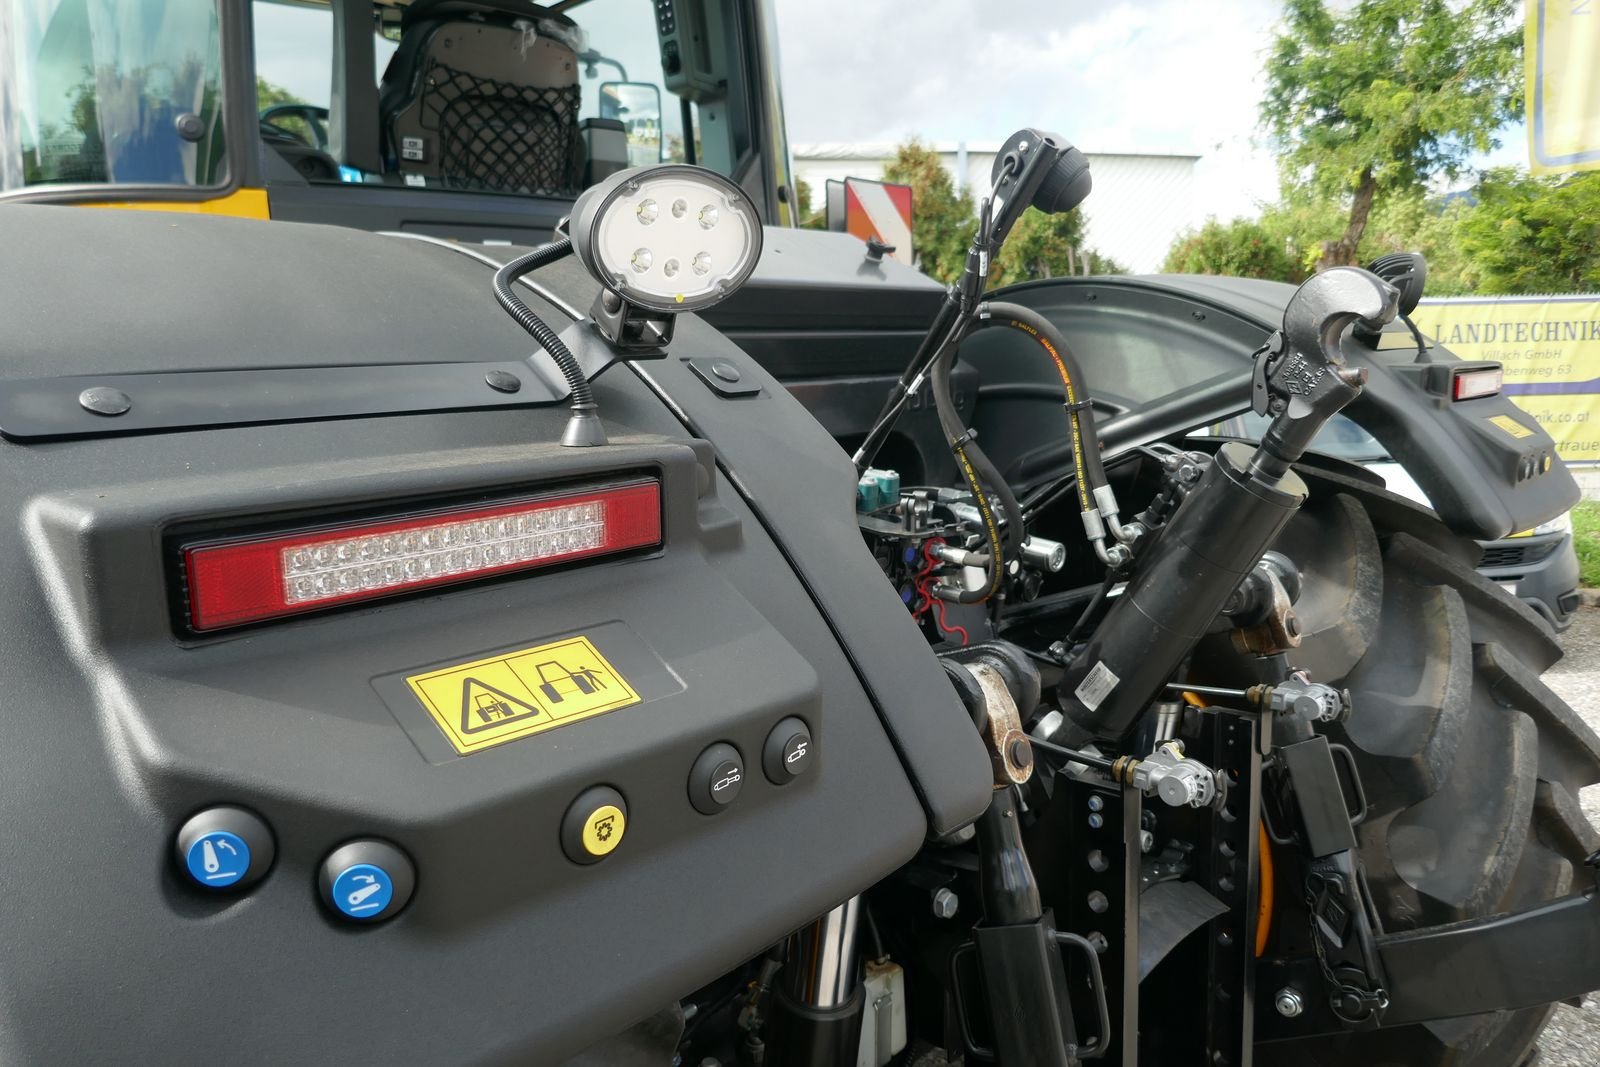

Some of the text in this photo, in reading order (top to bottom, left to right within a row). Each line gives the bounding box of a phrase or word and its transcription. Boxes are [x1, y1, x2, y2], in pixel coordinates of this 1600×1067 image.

[1434, 320, 1600, 345] LANDTECHNIK
[1481, 349, 1562, 361] Villach GmbH
[1503, 364, 1572, 378] benweg 63
[1529, 409, 1590, 423] nik.co.at
